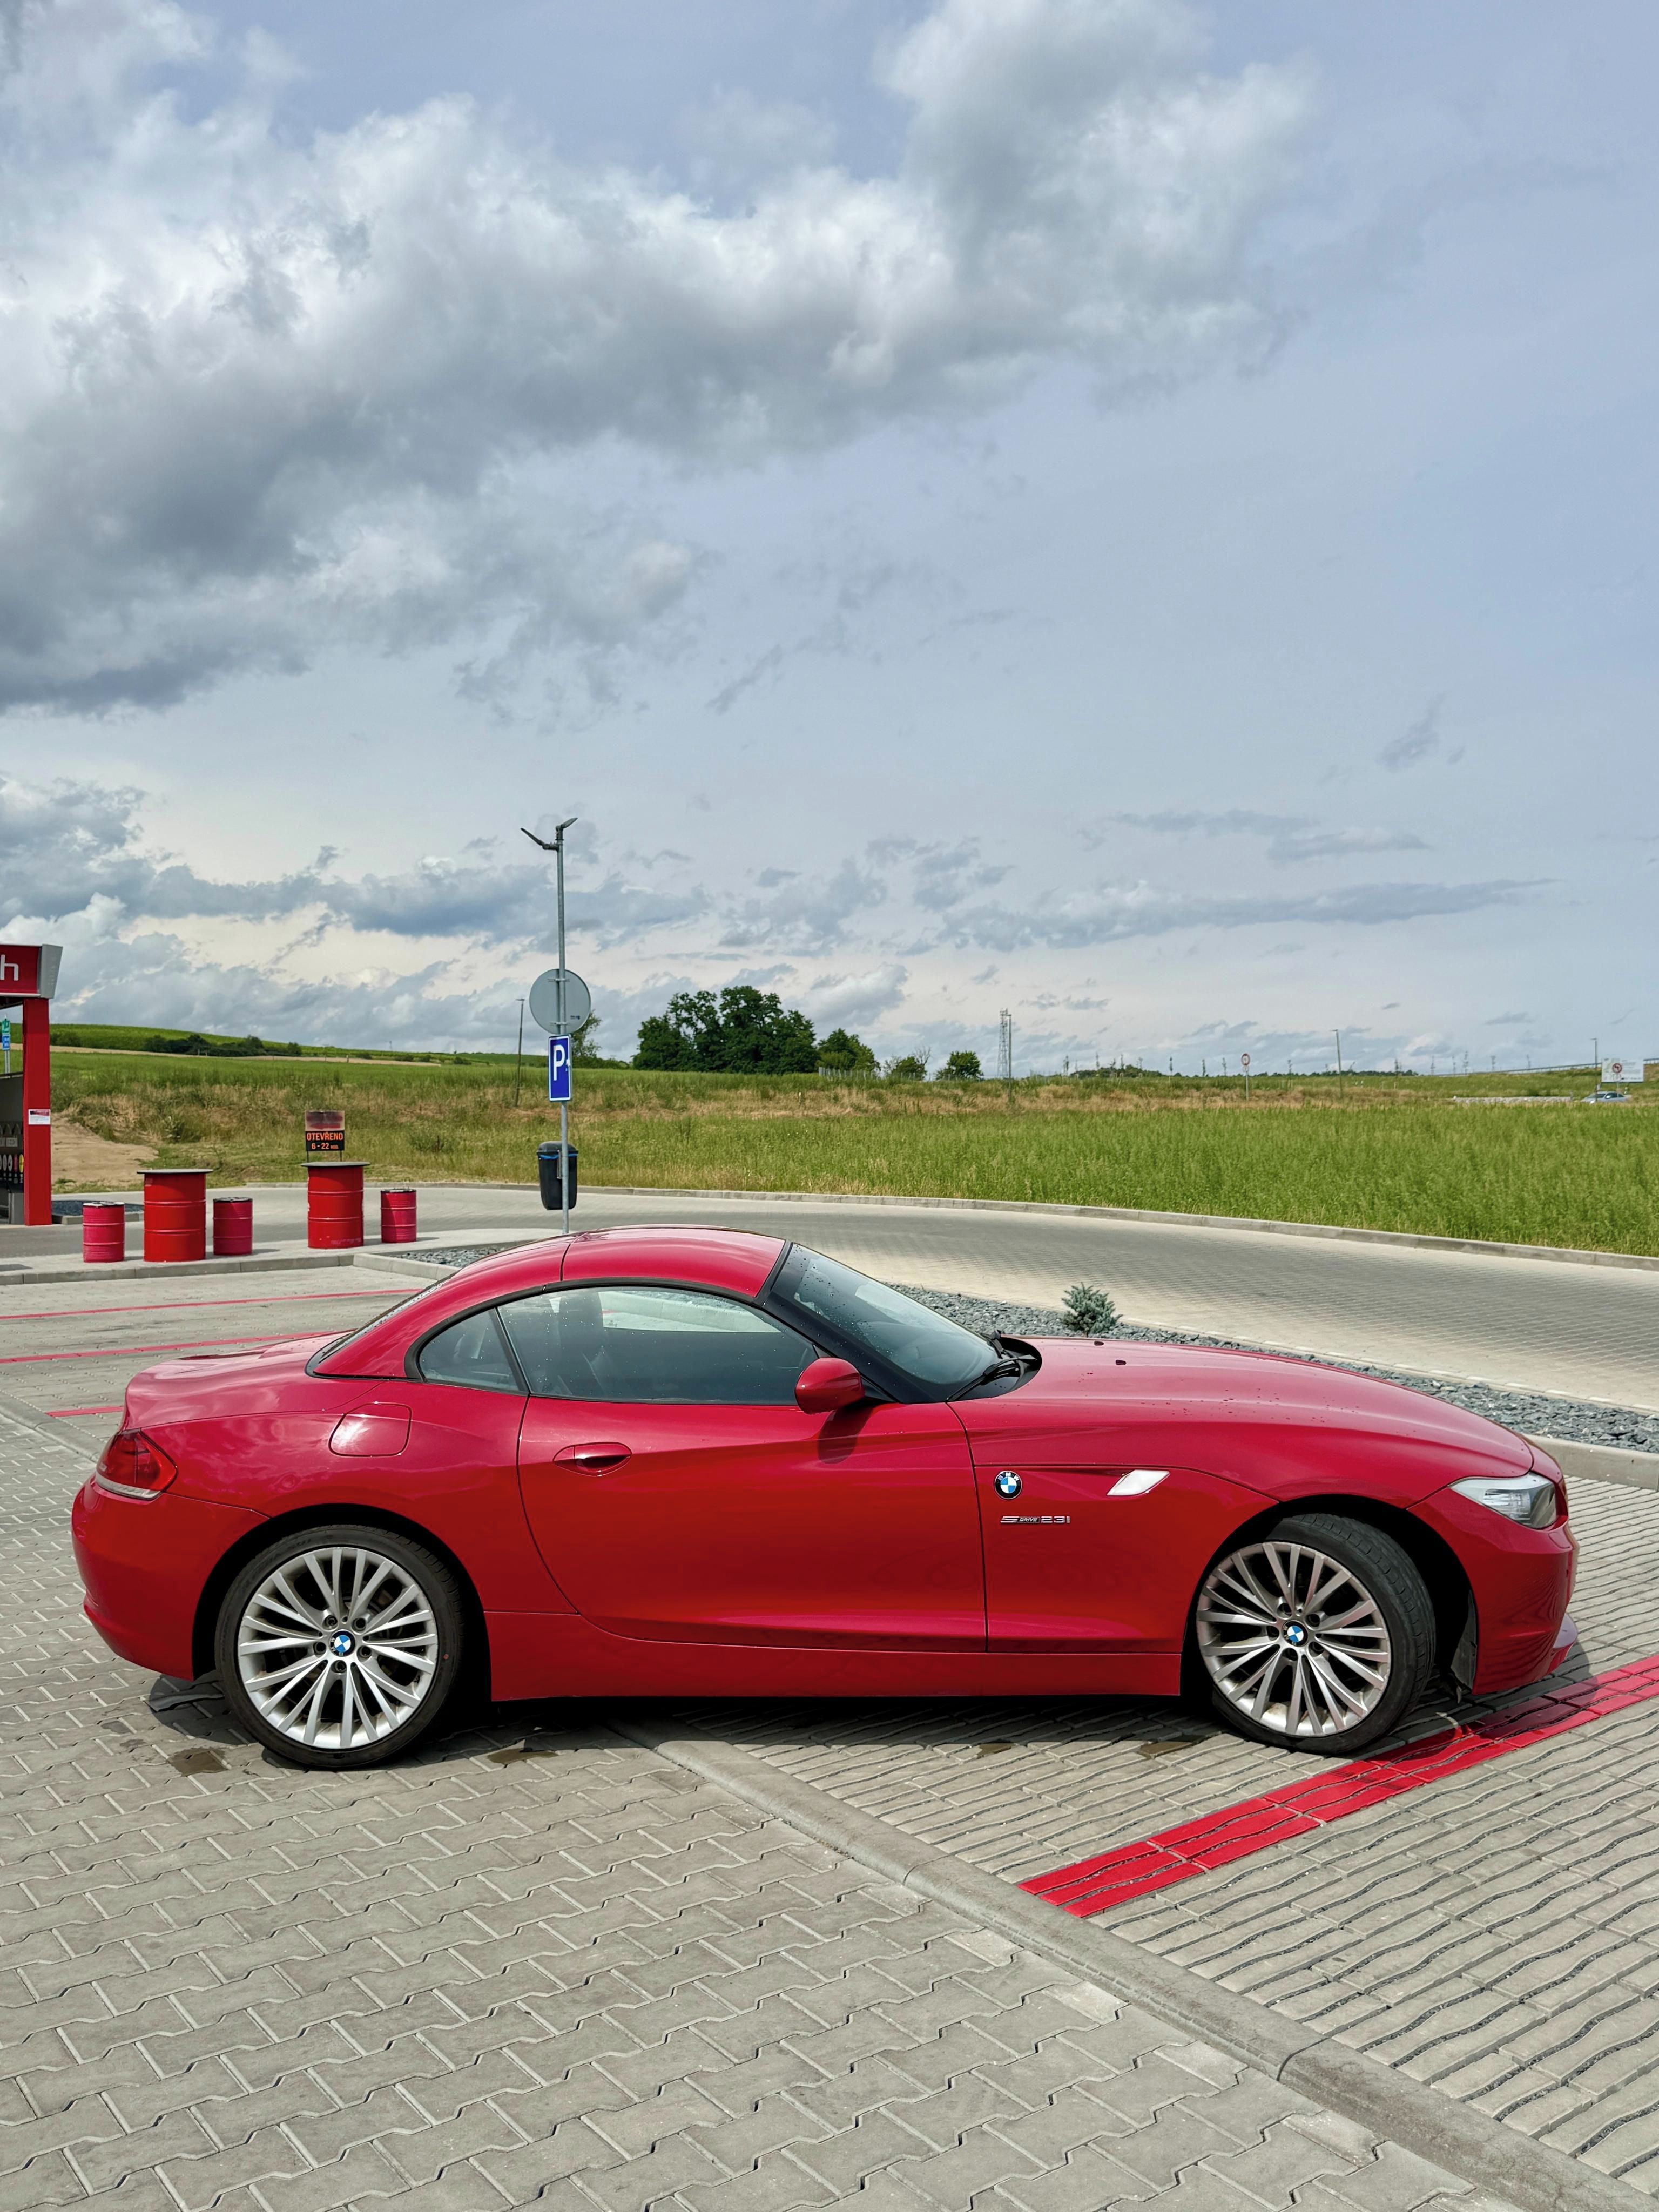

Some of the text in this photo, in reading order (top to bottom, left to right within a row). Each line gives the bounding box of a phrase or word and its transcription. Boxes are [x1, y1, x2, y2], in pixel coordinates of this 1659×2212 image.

[553, 1044, 565, 1081] P
[306, 1131, 343, 1141] OTEVŘENO
[997, 1472, 1020, 1481] BMW
